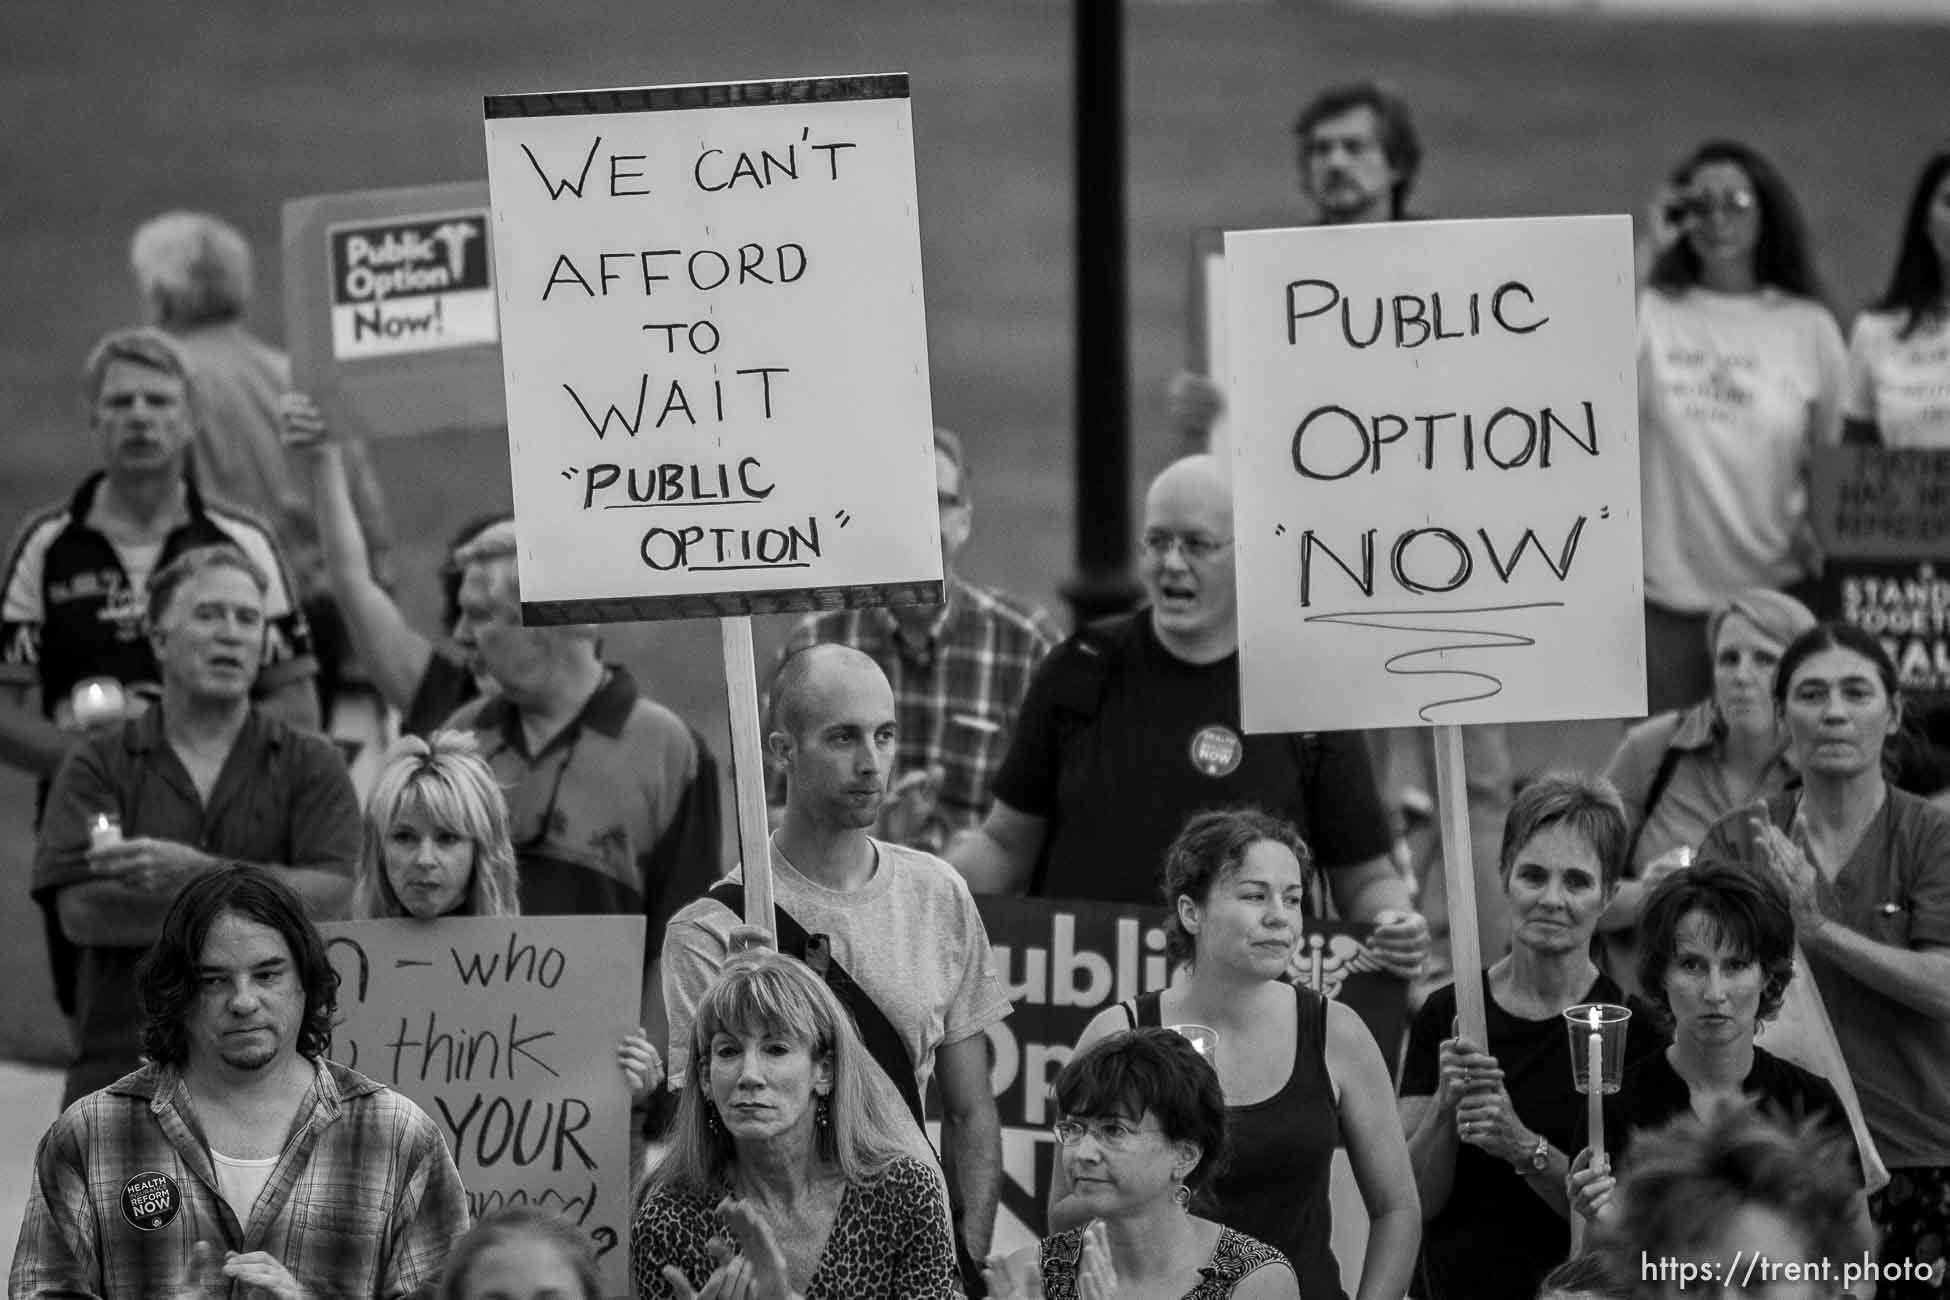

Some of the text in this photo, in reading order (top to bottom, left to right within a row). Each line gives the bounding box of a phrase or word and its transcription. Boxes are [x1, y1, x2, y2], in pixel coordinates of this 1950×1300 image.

[521, 127, 857, 200] WE CAN'T
[347, 230, 436, 267] Public
[542, 243, 808, 300] AFFORD
[346, 265, 449, 301] Option
[354, 296, 444, 343] Now!
[642, 320, 720, 354] TO
[1286, 279, 1549, 348] PUBLIC
[563, 367, 790, 440] WAIT
[1292, 402, 1600, 481] OPTION
[450, 931, 566, 989] who
[990, 913, 1168, 1009] ubli
[385, 1011, 560, 1085] think
[434, 1093, 598, 1172] YOUR
[127, 1176, 167, 1194] HEALTH
[130, 1189, 170, 1207] REFORM
[132, 1196, 170, 1217] NOW
